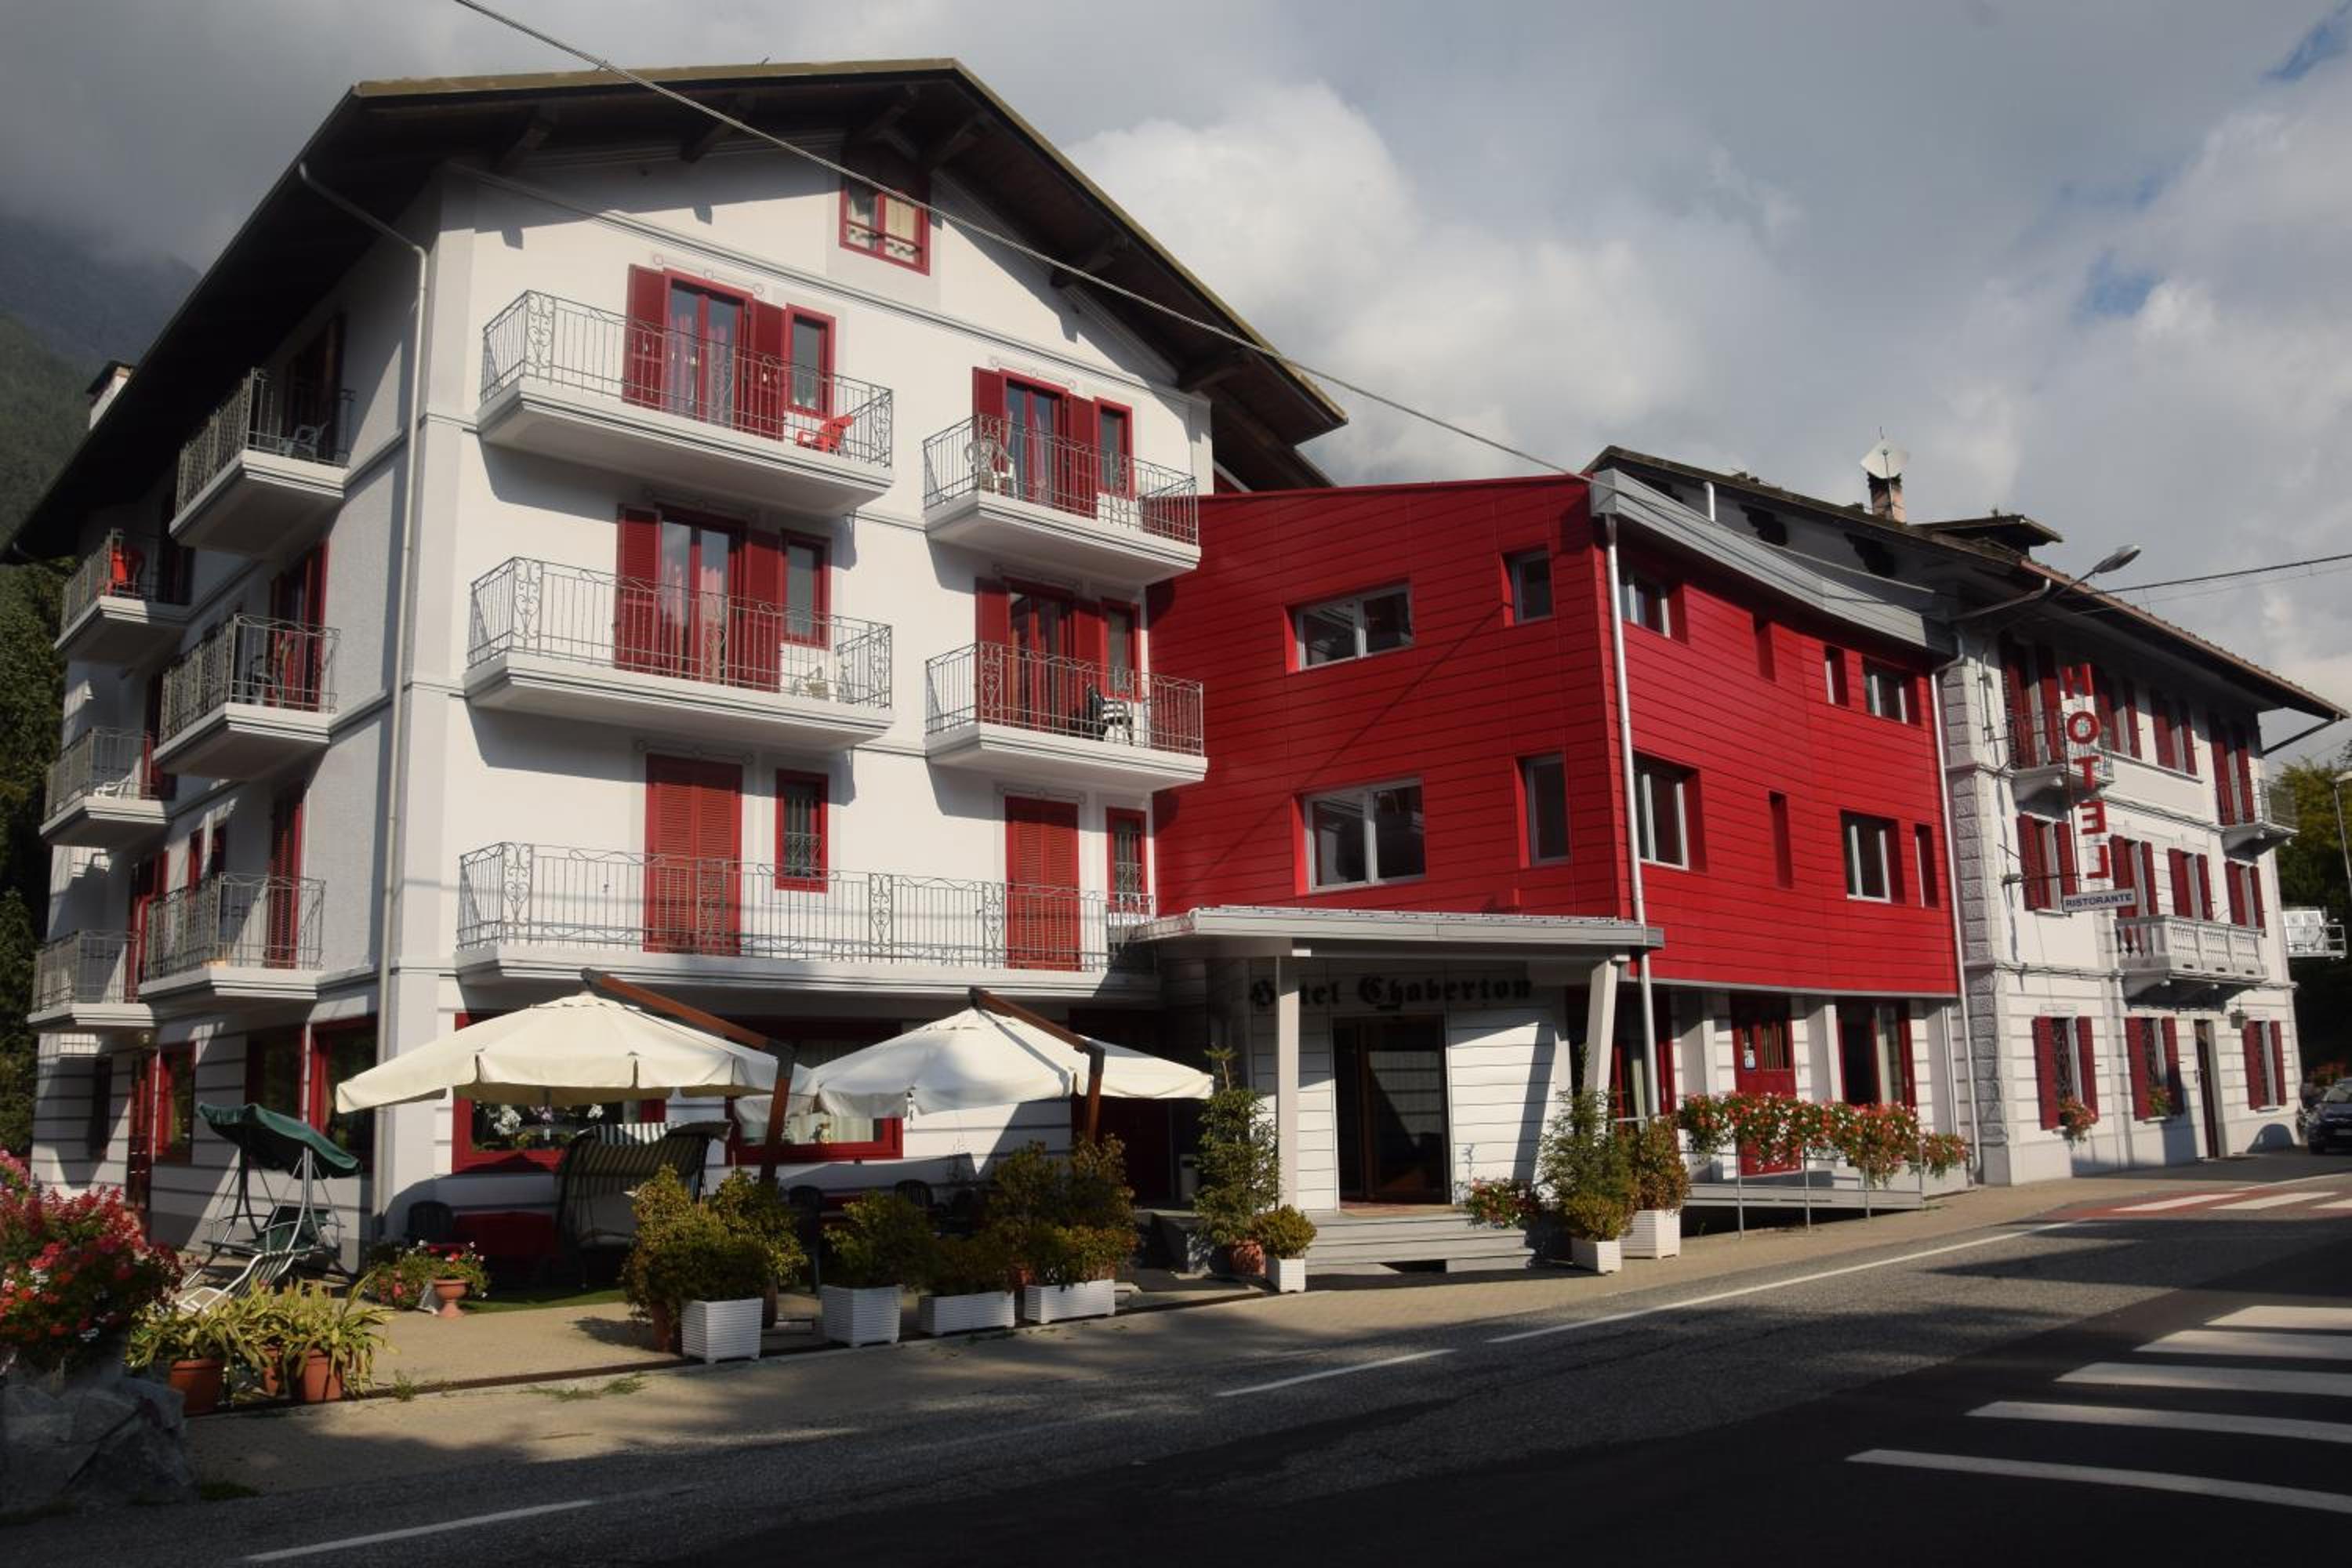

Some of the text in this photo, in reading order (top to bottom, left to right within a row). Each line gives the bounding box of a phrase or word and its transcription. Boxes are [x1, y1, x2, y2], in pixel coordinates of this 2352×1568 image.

[2065, 893, 2132, 907] RISTORANTE
[1250, 975, 1532, 1008] Htel Chaberton
